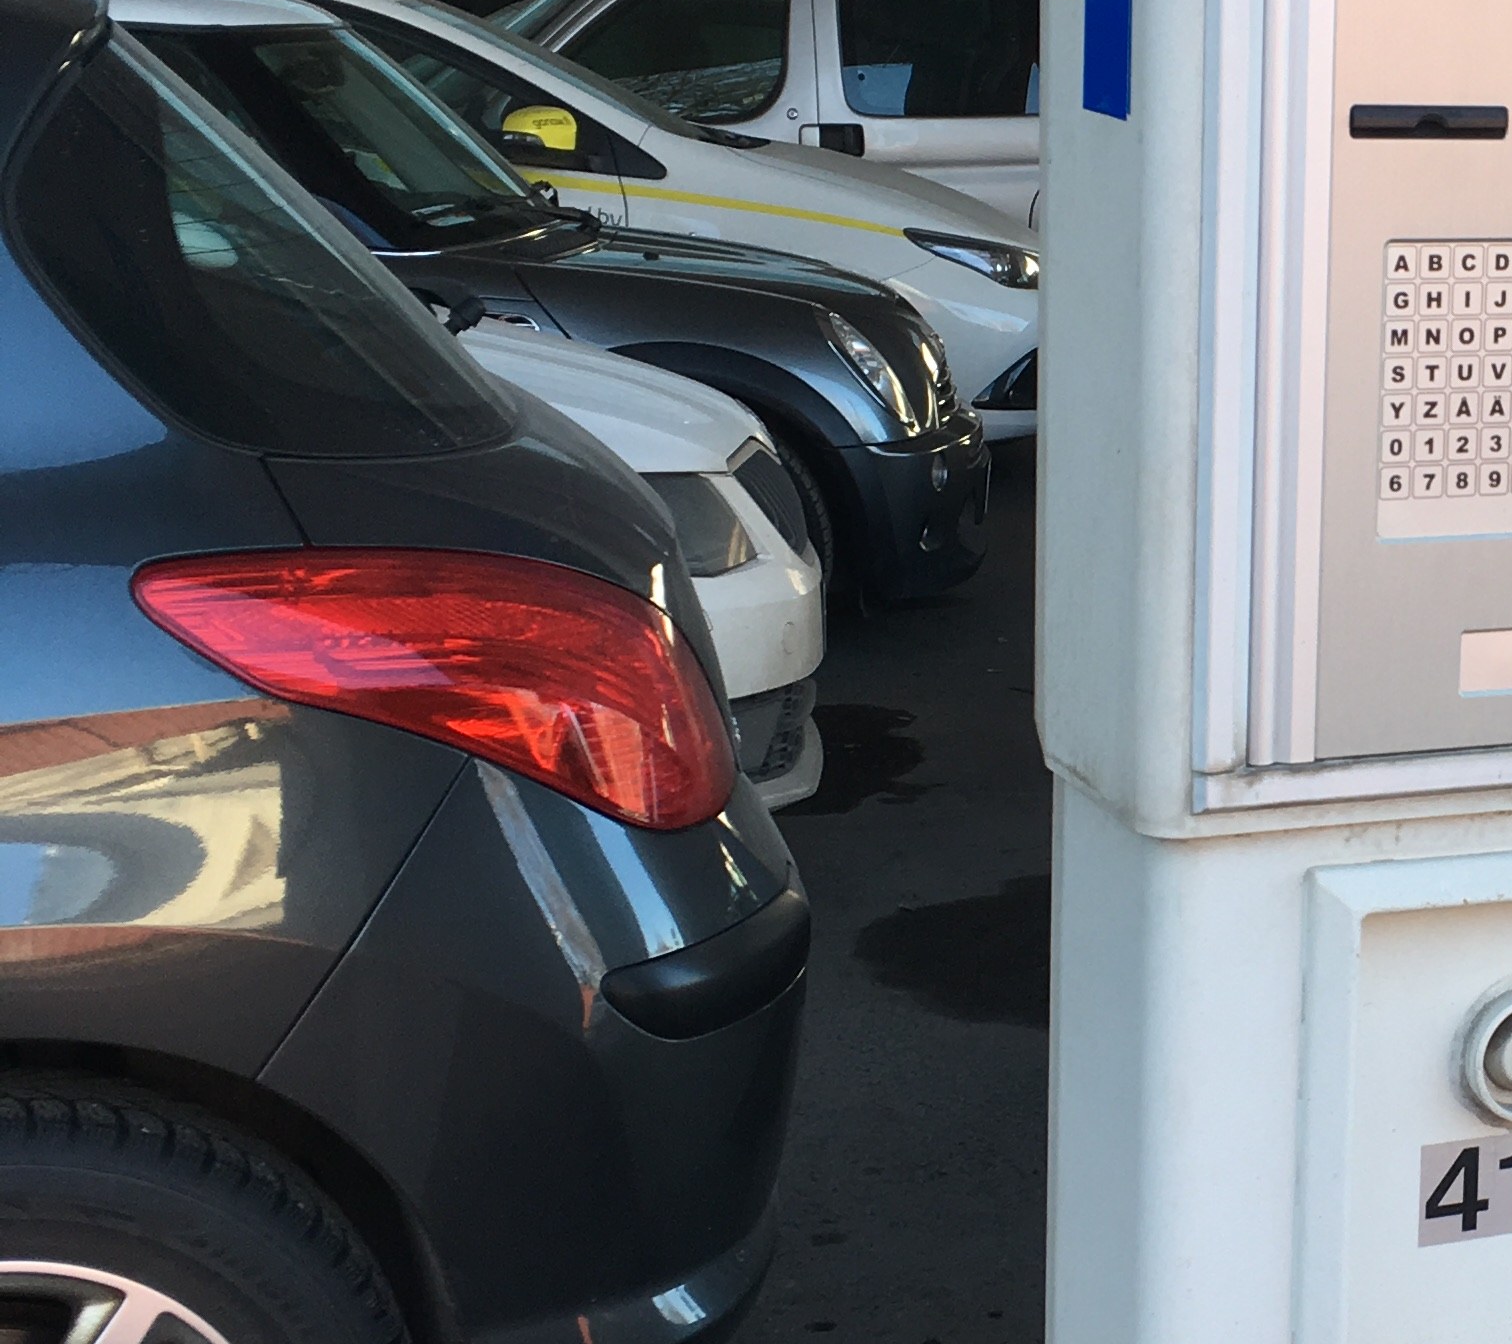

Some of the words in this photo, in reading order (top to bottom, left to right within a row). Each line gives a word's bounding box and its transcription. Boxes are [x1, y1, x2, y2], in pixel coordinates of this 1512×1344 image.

[1394, 255, 1409, 271] A
[1428, 255, 1442, 271] B
[1461, 254, 1476, 271] C
[1495, 254, 1510, 271] D
[1393, 291, 1409, 309] G
[1427, 291, 1442, 308] H
[1465, 290, 1470, 308] I
[1494, 290, 1507, 308] J
[1390, 329, 1408, 346] M
[1425, 328, 1441, 345] N
[1459, 327, 1474, 345] O
[1494, 327, 1507, 344] P
[1391, 365, 1405, 383] S
[1425, 365, 1439, 382] T
[1458, 364, 1473, 381] U
[1491, 363, 1506, 380] V
[1390, 402, 1404, 419] Y
[1423, 401, 1438, 418] Z
[1456, 396, 1471, 418] Å
[1489, 395, 1505, 417] Ä
[1390, 439, 1402, 456] 0
[1424, 438, 1434, 454] 1
[1456, 436, 1469, 453] 2
[1490, 435, 1502, 452] 3
[1389, 475, 1402, 492] 6
[1423, 473, 1436, 491] 7
[1456, 472, 1469, 489] 8
[1488, 470, 1501, 488] 9
